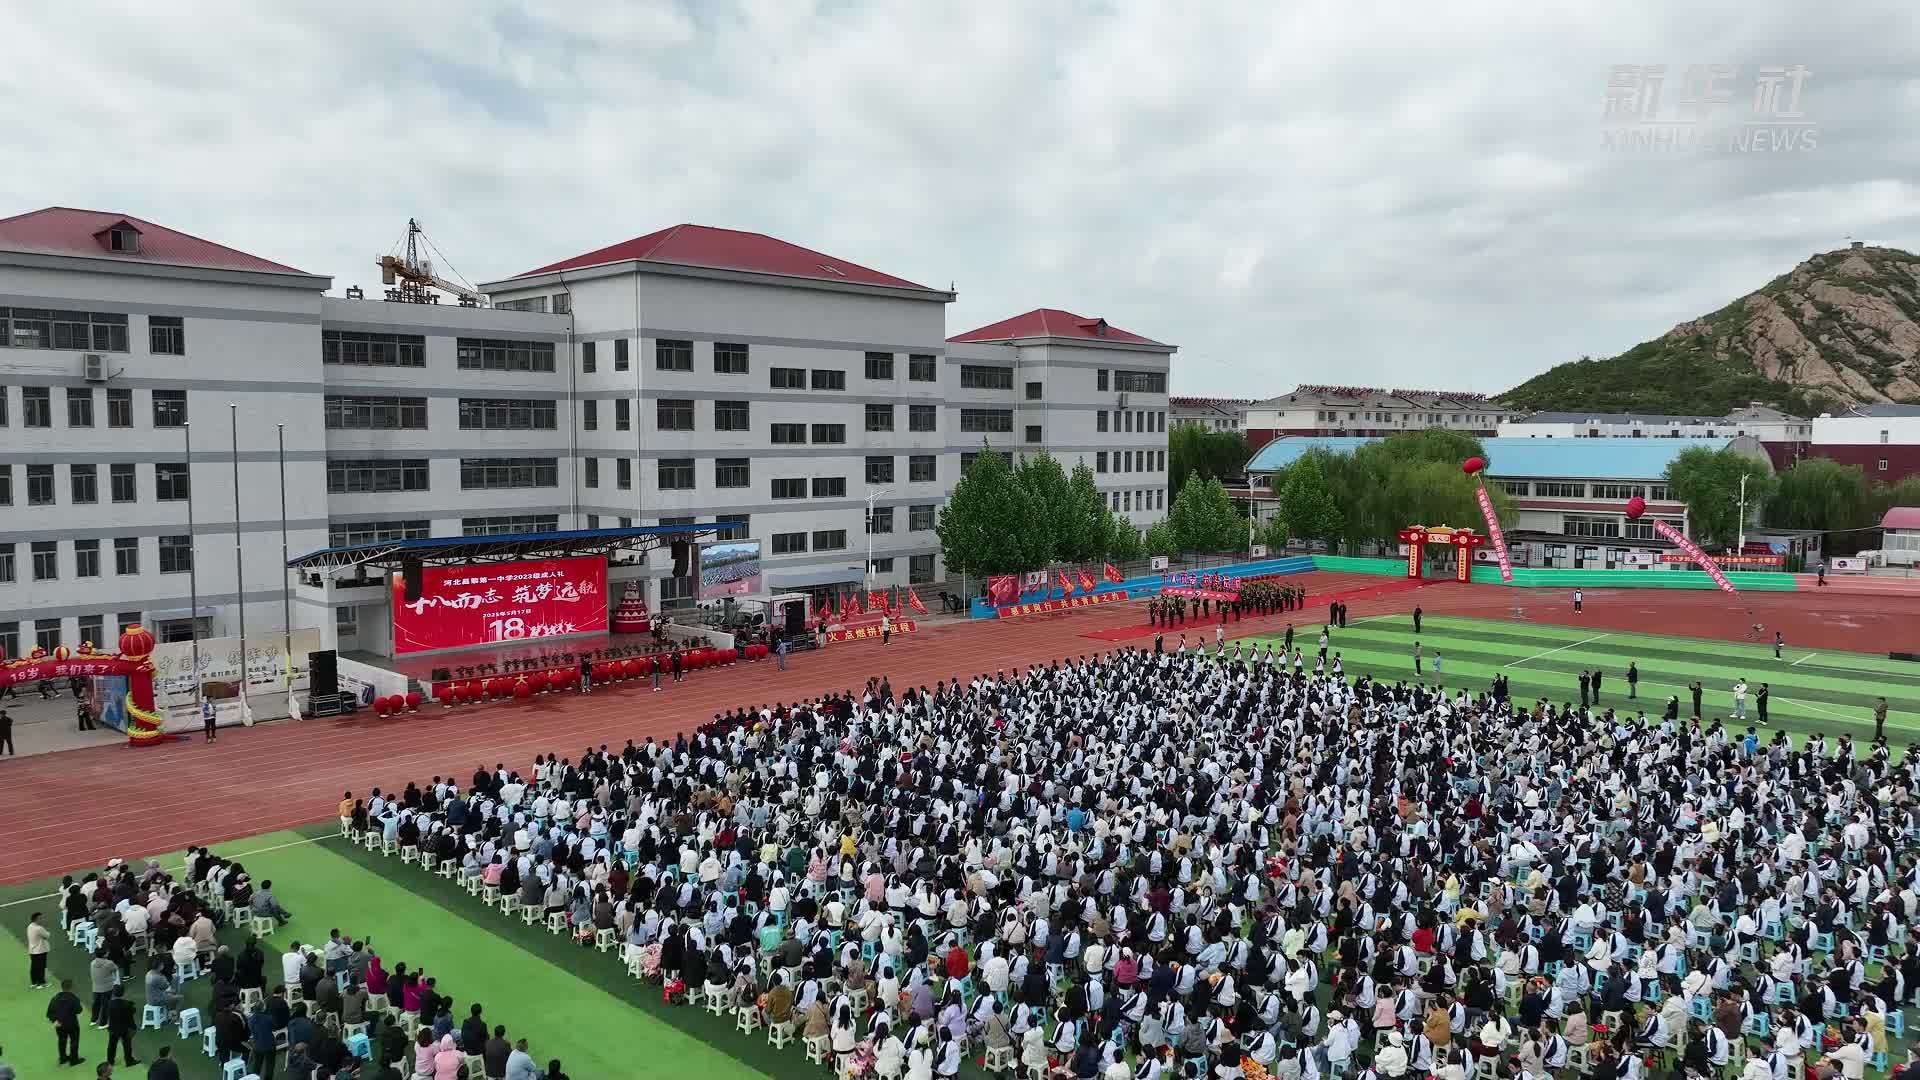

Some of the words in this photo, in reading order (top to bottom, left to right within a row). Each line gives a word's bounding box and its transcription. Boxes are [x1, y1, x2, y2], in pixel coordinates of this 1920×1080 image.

[405, 588, 504, 616] 十八而志
[511, 581, 598, 604] 筑梦远航
[488, 617, 525, 642] 18
